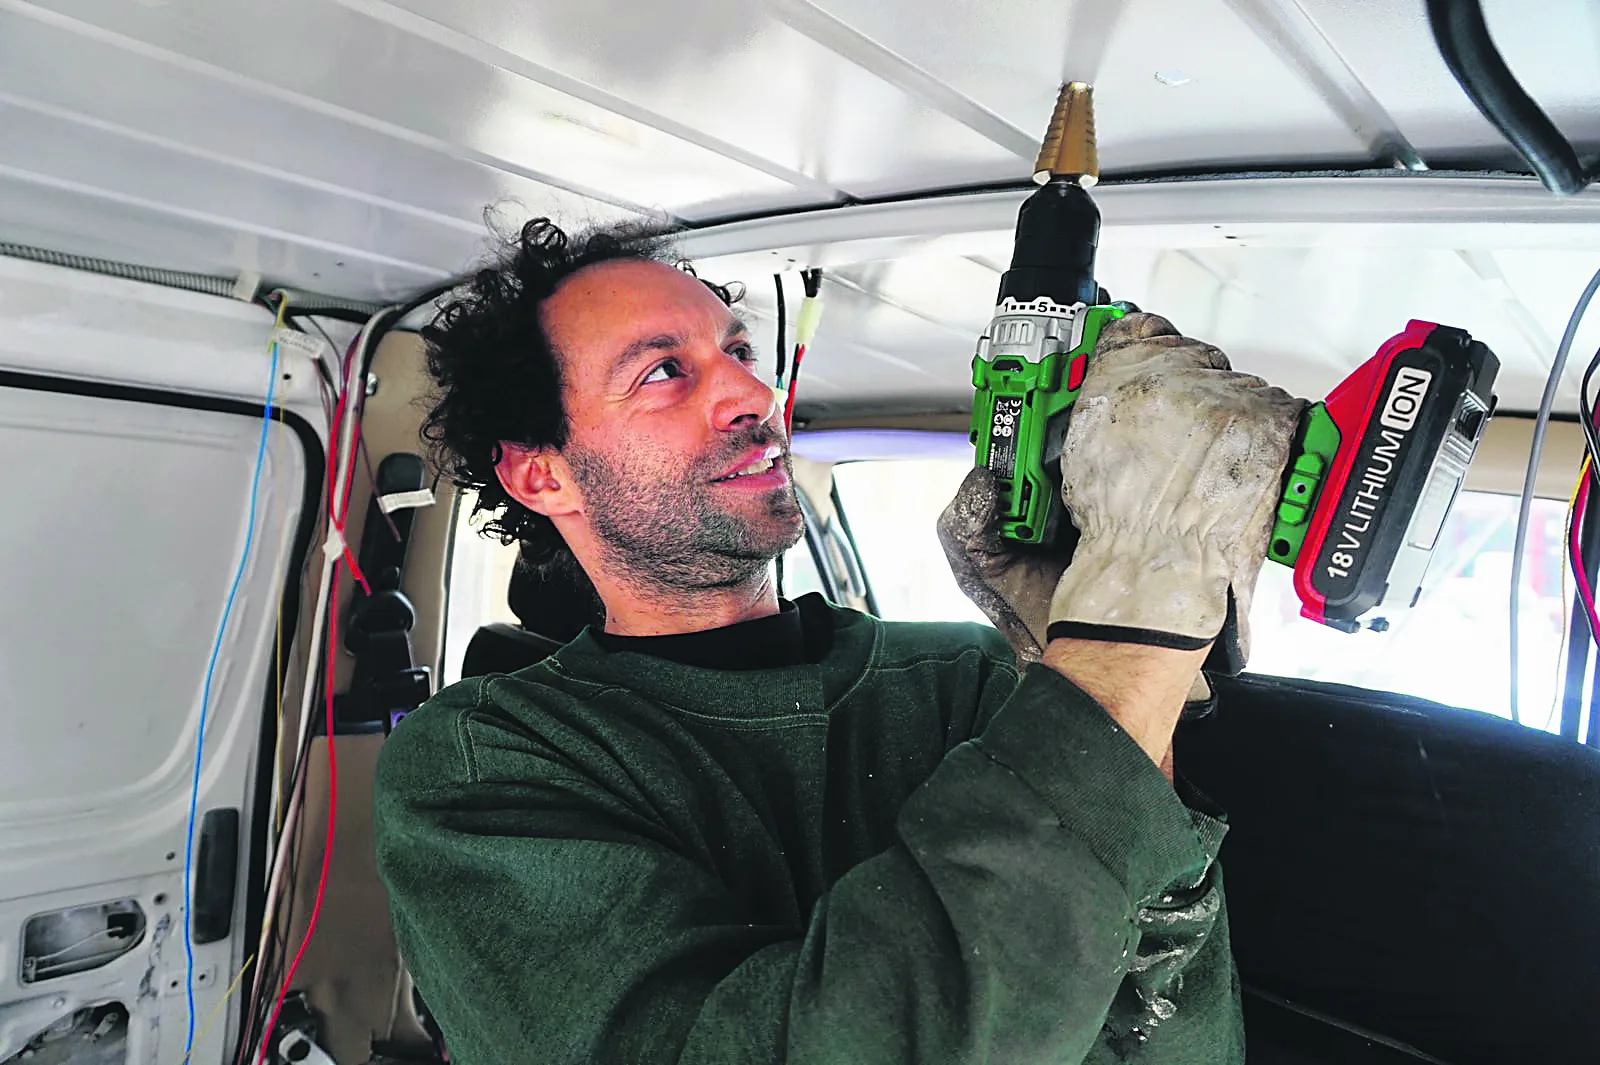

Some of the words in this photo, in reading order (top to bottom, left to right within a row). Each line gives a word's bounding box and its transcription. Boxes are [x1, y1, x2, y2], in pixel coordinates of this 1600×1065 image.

[1004, 302, 1009, 312] 1
[1037, 302, 1048, 313] 5
[1009, 400, 1022, 416] CE
[1344, 430, 1404, 532] LITHIUM
[1387, 374, 1426, 423] ION
